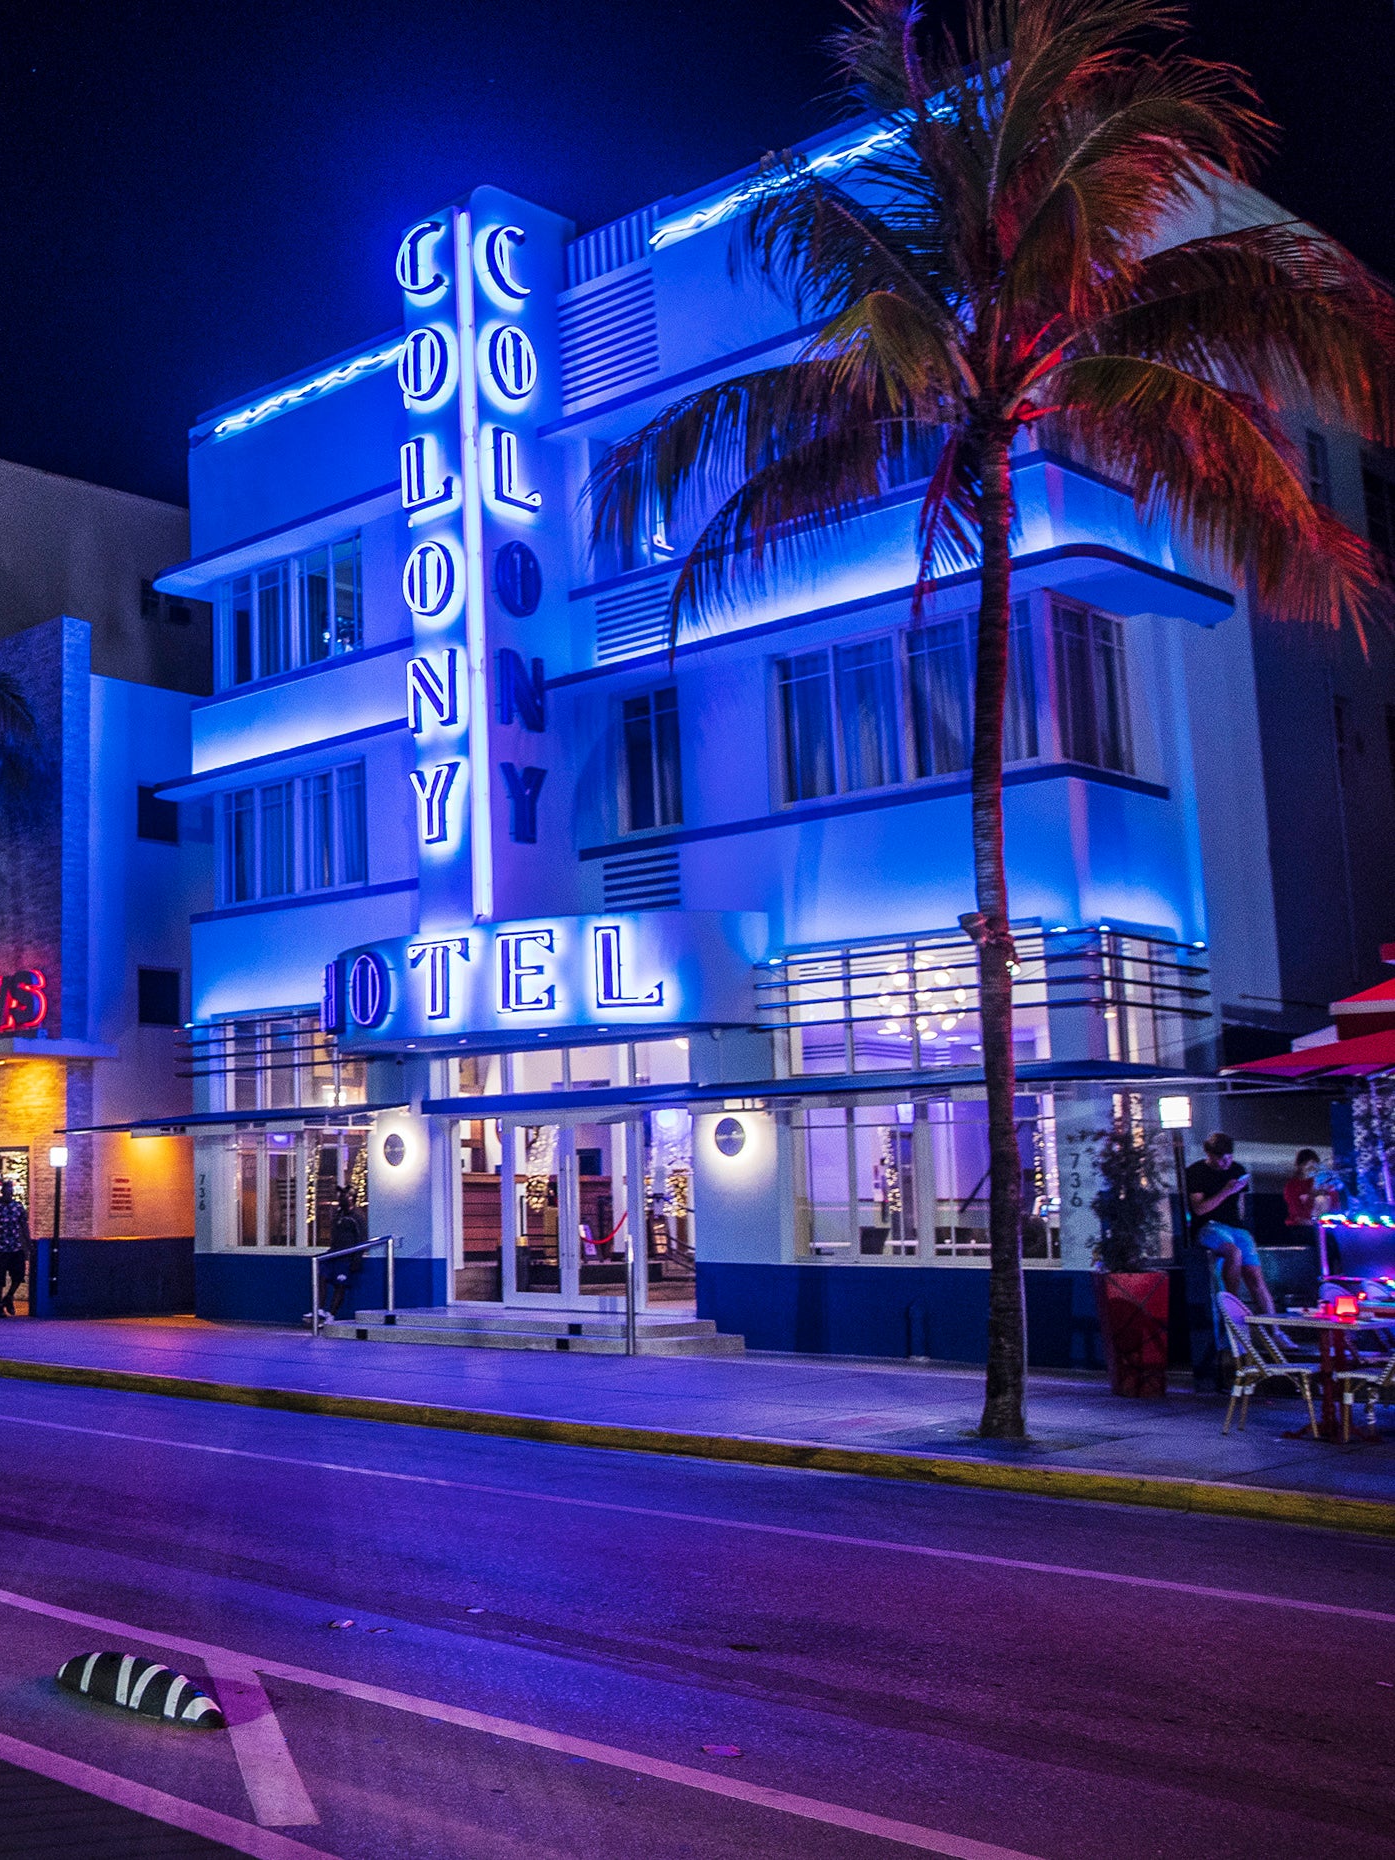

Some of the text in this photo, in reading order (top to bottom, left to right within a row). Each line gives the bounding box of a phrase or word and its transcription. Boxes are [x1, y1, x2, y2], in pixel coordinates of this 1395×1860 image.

[395, 221, 462, 844] COLONY
[485, 224, 547, 844] COLONY
[198, 1174, 207, 1211] 736
[1069, 1152, 1083, 1207] 736
